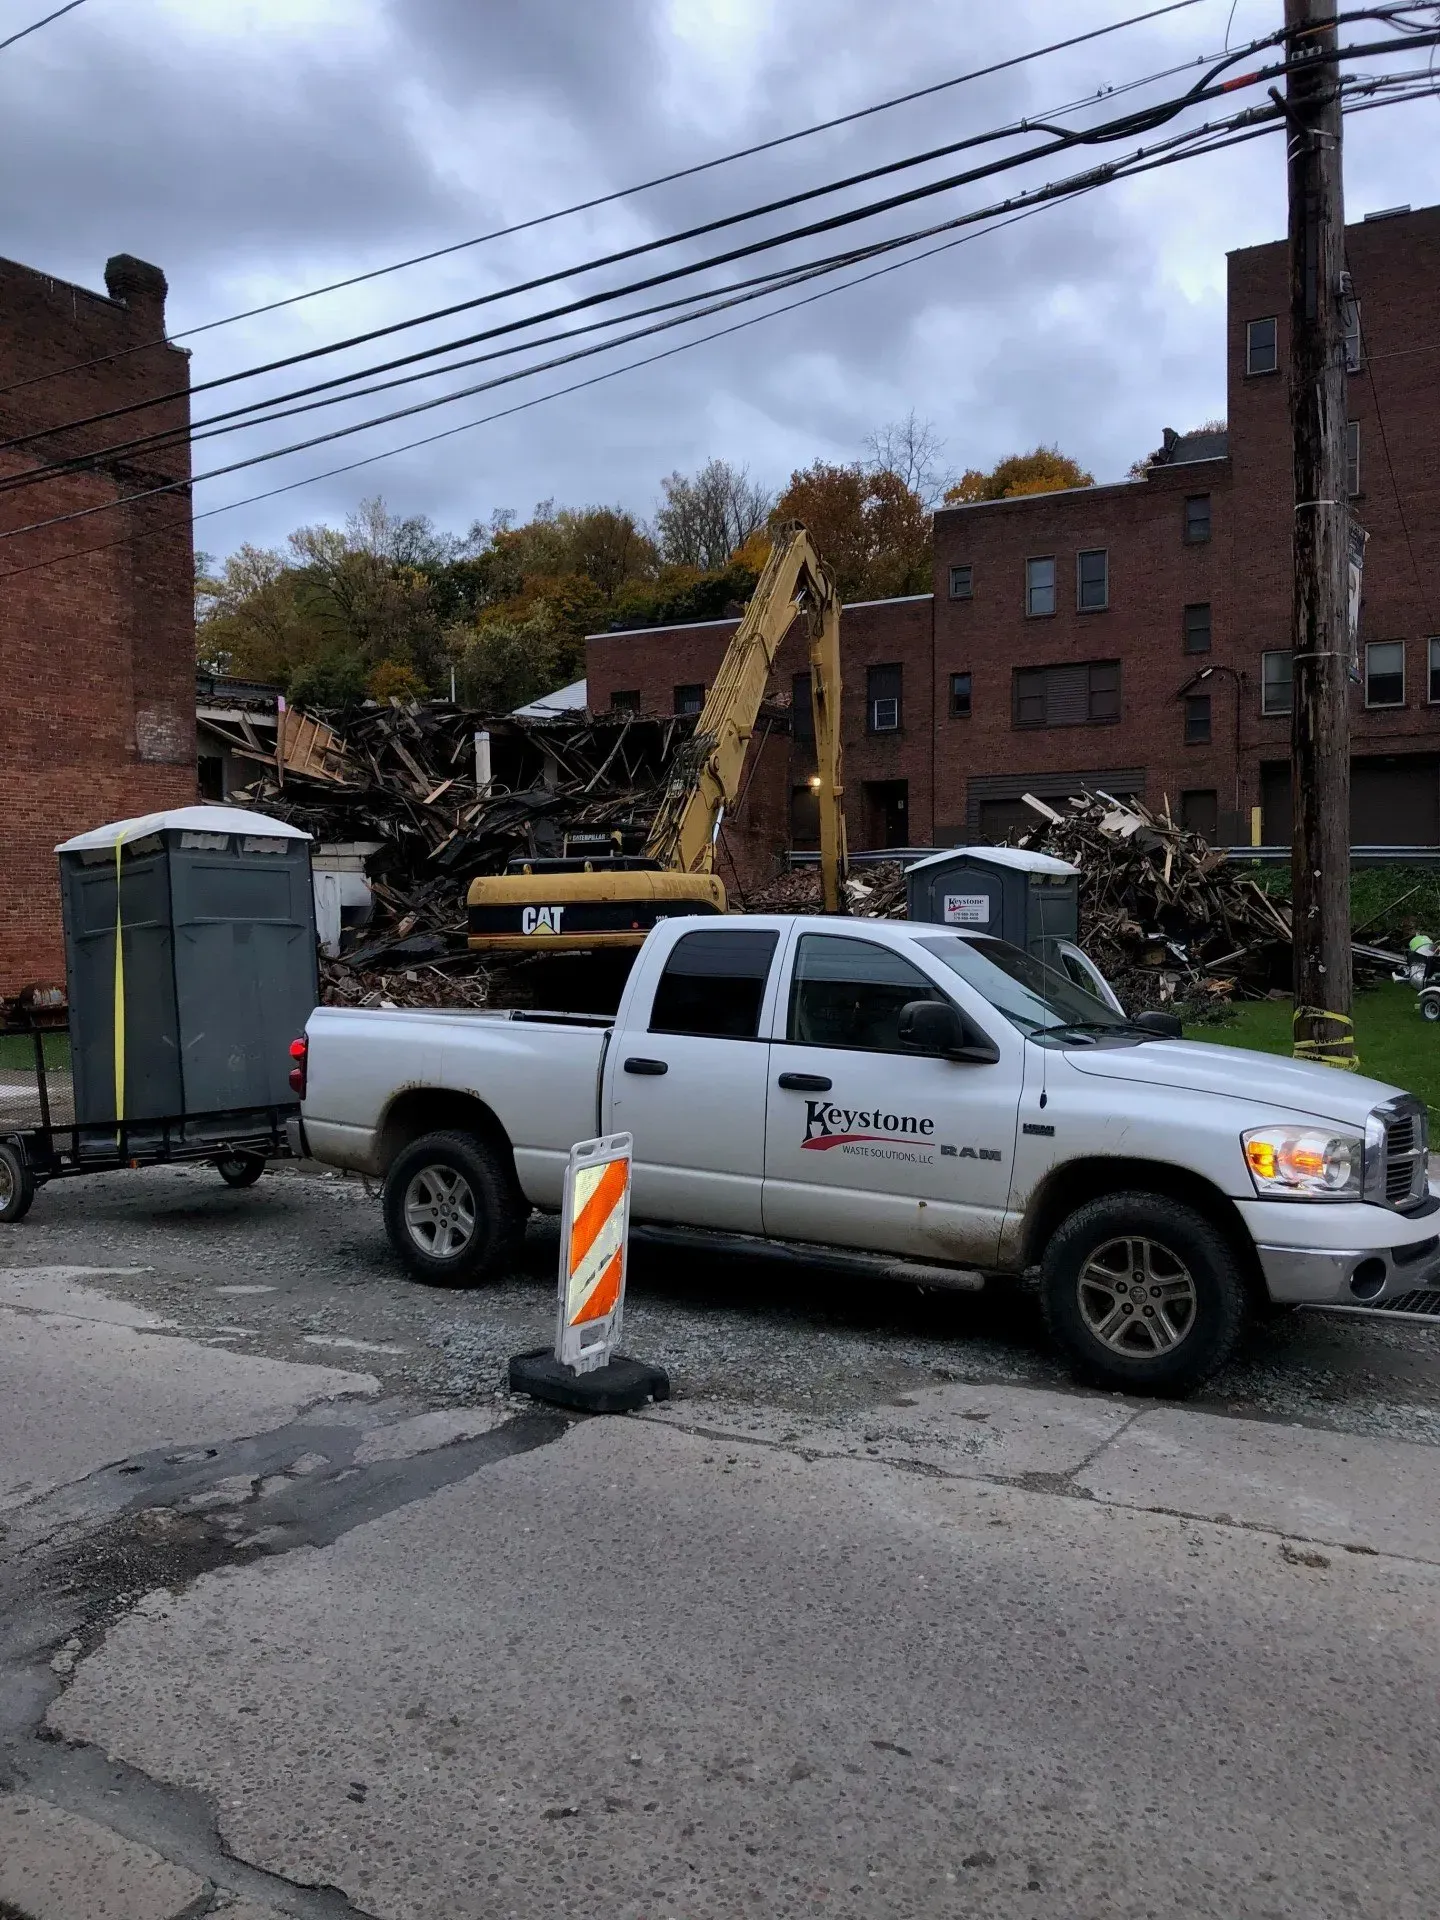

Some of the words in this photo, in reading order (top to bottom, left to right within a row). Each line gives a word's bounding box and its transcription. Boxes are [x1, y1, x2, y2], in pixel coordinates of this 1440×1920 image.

[948, 898, 984, 909] Keystone
[522, 906, 564, 935] CAT
[802, 1100, 935, 1142] Keystone
[842, 1145, 869, 1157] WASTE
[870, 1148, 917, 1163] SOLUTIONS,
[919, 1154, 934, 1165] LLC
[940, 1144, 1002, 1161] RAM
